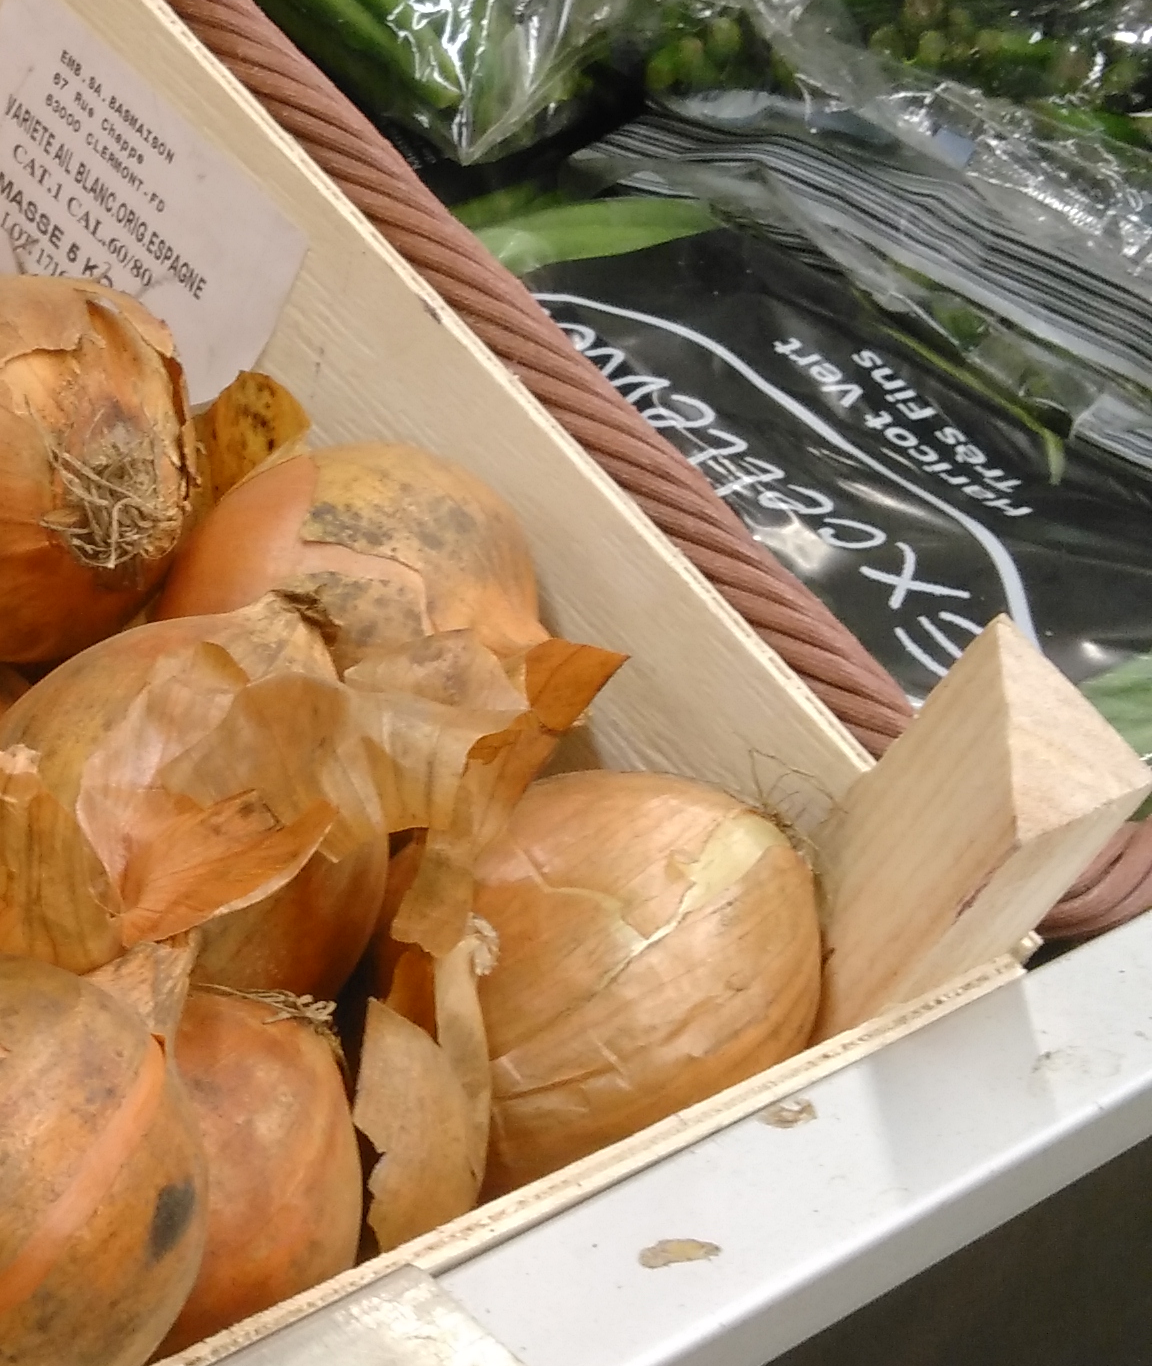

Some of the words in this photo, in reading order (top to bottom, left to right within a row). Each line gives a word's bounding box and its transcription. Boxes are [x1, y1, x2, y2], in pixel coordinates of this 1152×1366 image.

[4, 93, 56, 156] VARIETE
[52, 142, 75, 176] AIL
[45, 93, 82, 134] 63000
[73, 91, 96, 119] Rue
[771, 336, 865, 409] Vert
[850, 347, 936, 422] Fins
[863, 410, 1034, 518] Haricot
[934, 425, 1023, 495] Très
